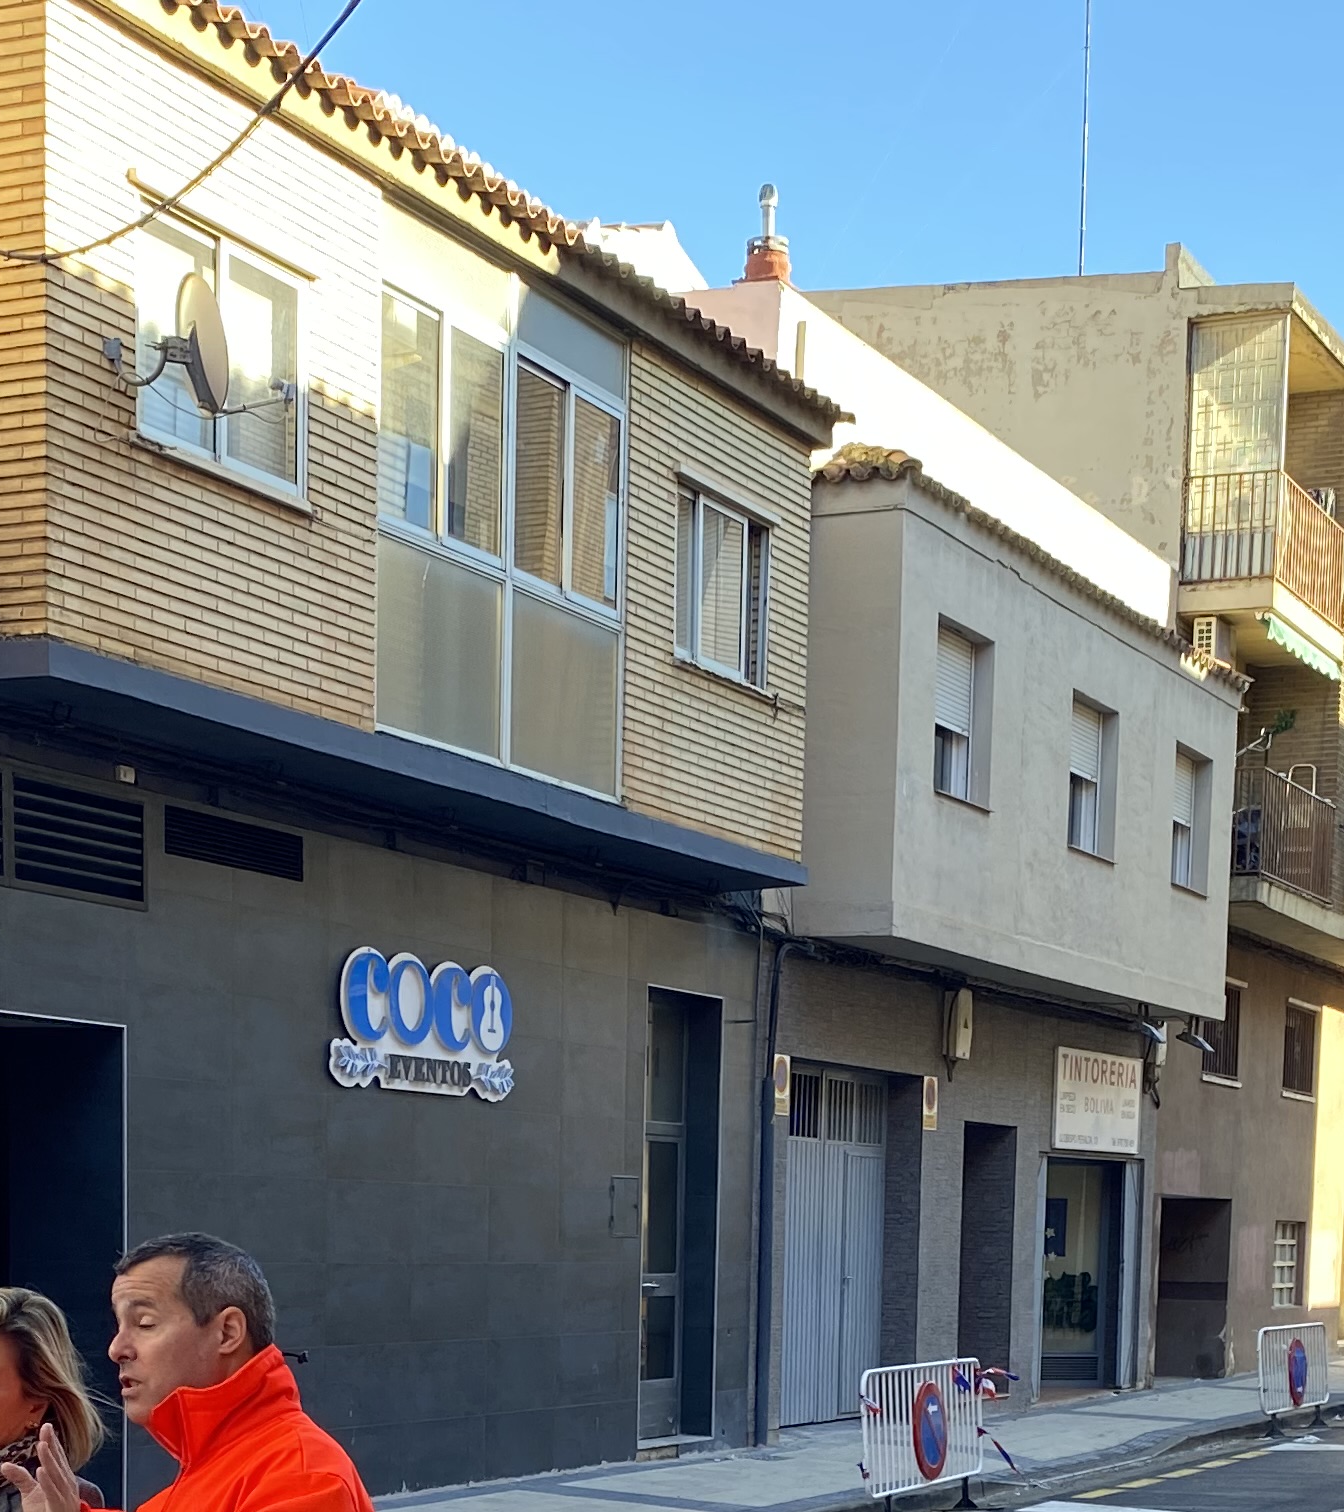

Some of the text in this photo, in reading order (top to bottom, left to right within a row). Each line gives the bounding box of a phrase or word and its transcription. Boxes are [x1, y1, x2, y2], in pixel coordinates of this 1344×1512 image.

[347, 952, 513, 1054] COCO
[386, 1054, 472, 1087] EVENTOS
[1062, 1053, 1137, 1089] TINTORERIA
[1084, 1096, 1114, 1114] BOLIVIA
